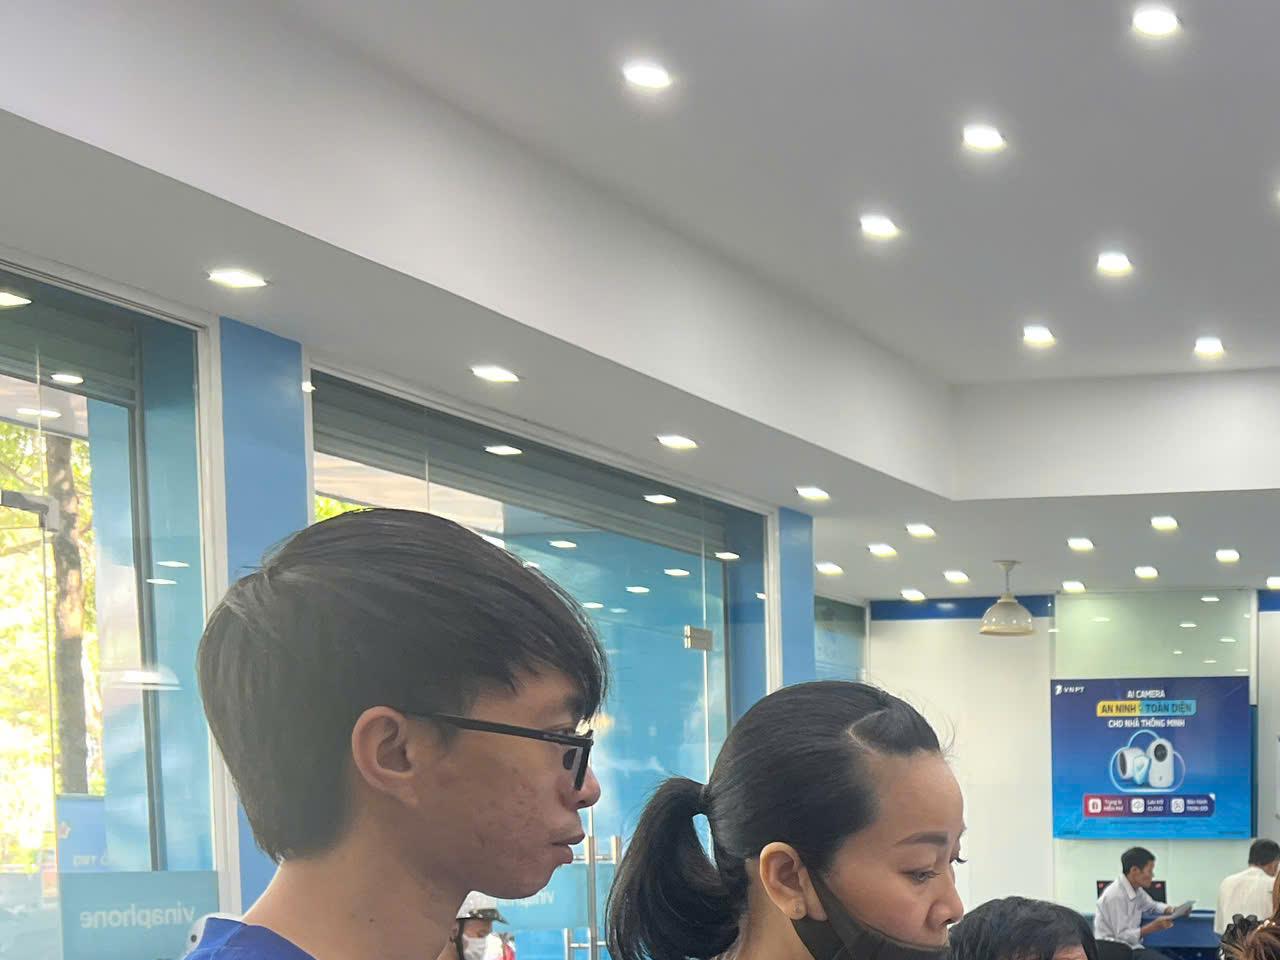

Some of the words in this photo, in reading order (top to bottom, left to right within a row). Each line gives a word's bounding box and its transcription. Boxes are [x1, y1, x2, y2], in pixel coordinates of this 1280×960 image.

[1063, 686, 1085, 694] VNPT
[1135, 689, 1166, 698] CAMERA
[1101, 704, 1113, 713] AN
[1115, 703, 1137, 713] NINH
[1108, 720, 1123, 728] CHO
[1166, 719, 1185, 728] MINH
